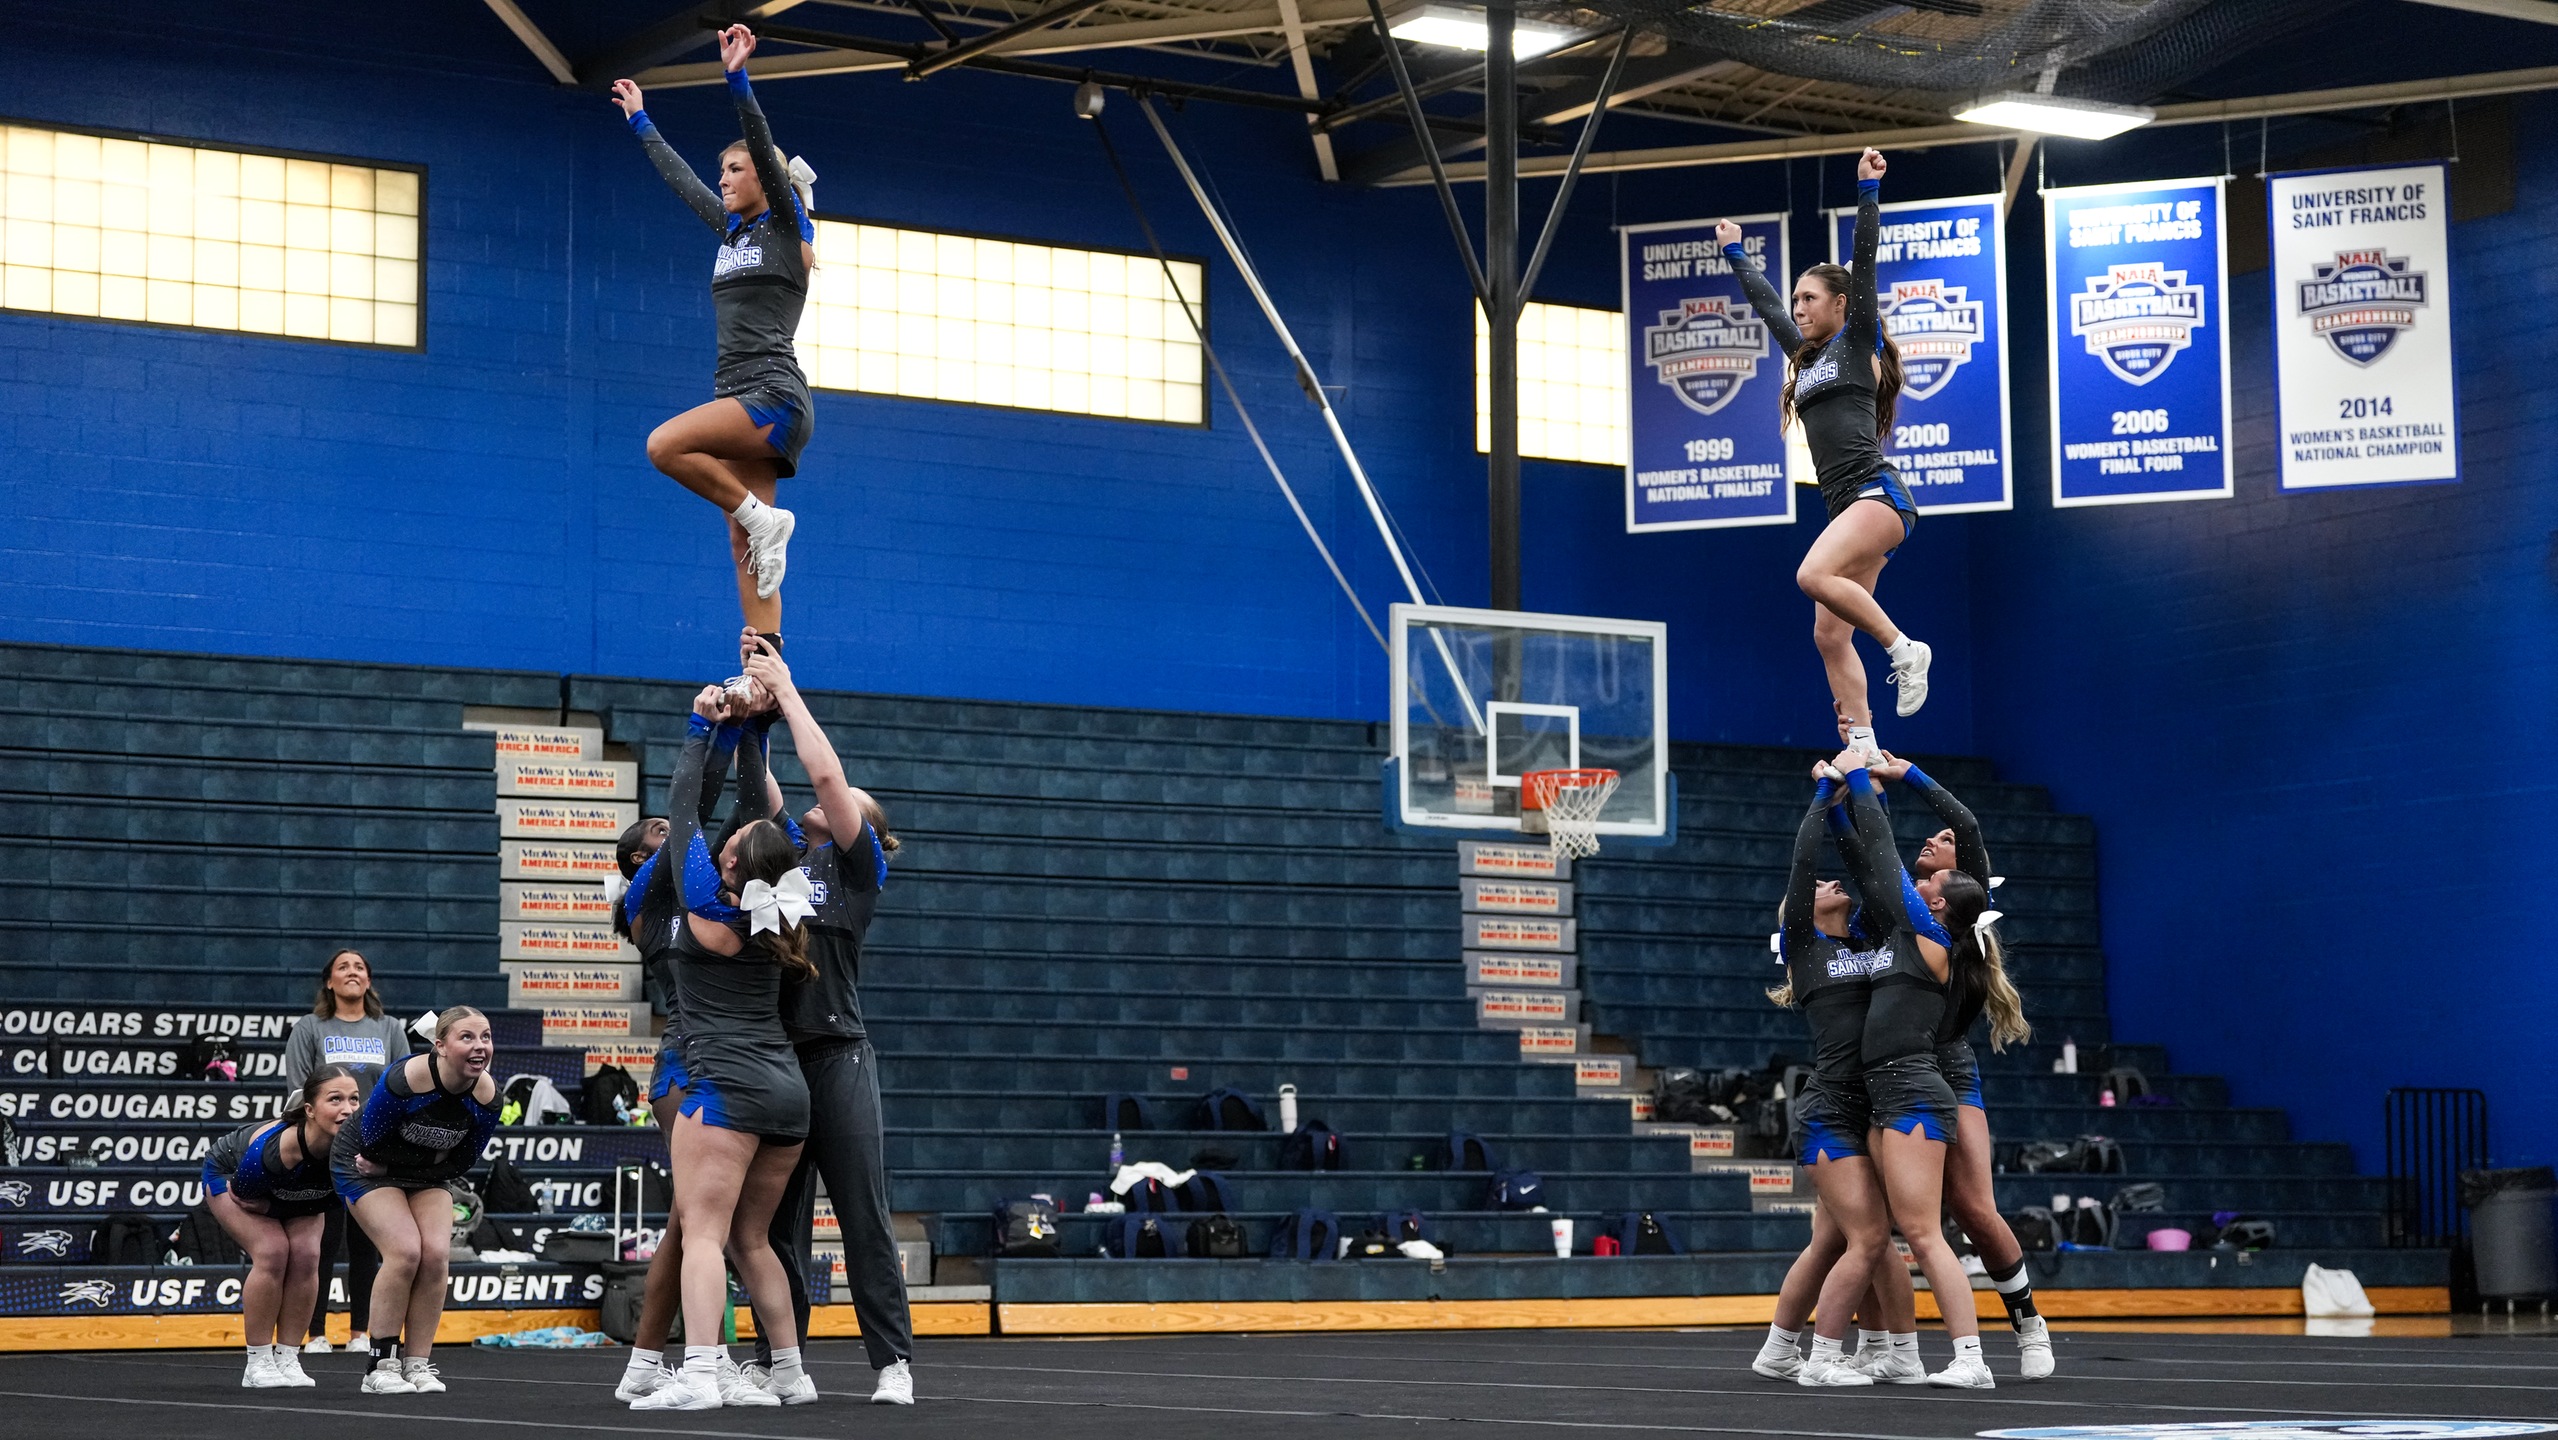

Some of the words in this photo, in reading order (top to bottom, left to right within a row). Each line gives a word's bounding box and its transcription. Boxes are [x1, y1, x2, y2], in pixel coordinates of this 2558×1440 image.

[2293, 186, 2396, 210] UNIVERSITY
[2403, 184, 2425, 201] OF
[2069, 202, 2173, 228] UNIVERSITY
[2176, 201, 2201, 220] OF
[2293, 210, 2343, 229] SAINT
[2350, 204, 2426, 224] FRANCIS
[1956, 218, 1980, 237] OF
[2125, 220, 2202, 243] FRANCIS
[1643, 240, 1720, 262] UNIVERSI
[1744, 236, 1766, 254] OF
[1907, 237, 1981, 260] FRANCIS
[1644, 261, 1691, 281] SAINT
[1695, 254, 1767, 276] FRAIS
[2339, 251, 2383, 269] NAIA
[2116, 269, 2158, 284] NAIA
[1898, 285, 1939, 301] NAIA
[2304, 277, 2421, 309] BASKETBALL
[1685, 302, 1725, 318] NAIA
[2080, 294, 2195, 325] BASKETBALL
[2315, 311, 2412, 330] CHAMPIONSHIP
[1886, 310, 1975, 336] SKETBALL
[1653, 326, 1760, 354] BASKETBALL
[1665, 358, 1750, 375] CHAMPIONSHIP
[2340, 397, 2393, 419] 2014
[2112, 408, 2169, 435] 2006
[1895, 423, 1950, 448] 2000
[2290, 428, 2354, 445] WOMEN'S
[2359, 423, 2445, 440] BASKETBALL
[1684, 437, 1734, 462] 1999
[1914, 449, 1998, 469] BASKETBALL
[2065, 441, 2130, 460] WOMEN'S
[2131, 436, 2218, 456] BASKETBALL
[2295, 446, 2361, 462] NATIONAL
[2366, 441, 2442, 457] CHAMPION
[1637, 469, 1699, 487] WOMEN'S
[1701, 463, 1783, 482] BASKETBALL
[2100, 458, 2142, 475] FINAL
[2143, 455, 2183, 472] FOUR
[1926, 468, 1964, 485] FOUR
[1647, 485, 1711, 503] NATIONAL
[1714, 481, 1773, 498] FINALIST
[496, 742, 530, 752] ERICA
[533, 744, 580, 754] AMERICA
[517, 776, 564, 786] AMERICA
[568, 778, 615, 788] AMERICA
[518, 818, 565, 827] AMERICA
[569, 820, 616, 829] AMERICA
[521, 859, 568, 869] AMERICA
[521, 902, 568, 911] AMERICA
[572, 903, 612, 912] AMERIC
[521, 940, 568, 949] AMERICA
[572, 941, 619, 950] AMERICA
[522, 981, 569, 990] AMERICA
[573, 982, 619, 990] AMERICA
[0, 1010, 143, 1036] OUGARS
[543, 1019, 577, 1027] ERICA
[581, 1020, 628, 1029] AMERICA
[324, 1036, 385, 1054] COUGAR
[587, 1055, 612, 1063] RICA
[616, 1056, 655, 1064] AMERIC
[0, 1093, 40, 1117] SF
[50, 1094, 217, 1119] COUGARS
[90, 1136, 211, 1161] COUGA
[482, 1137, 583, 1161] CTION
[48, 1180, 119, 1206] USF
[132, 1279, 205, 1306] USF
[447, 1275, 573, 1302] UDENT
